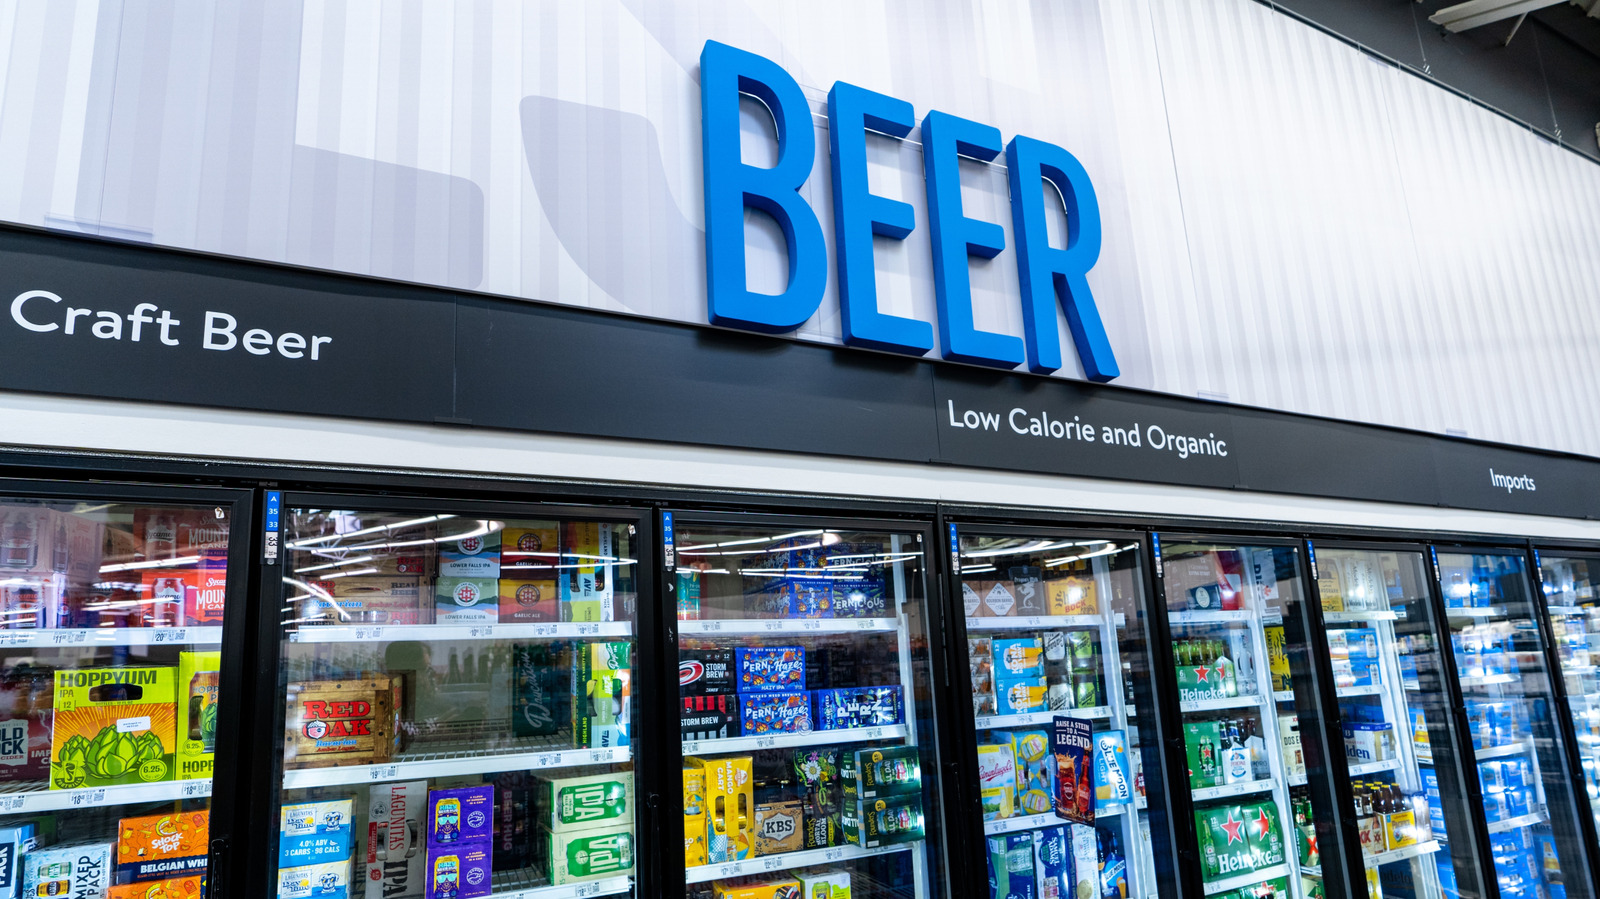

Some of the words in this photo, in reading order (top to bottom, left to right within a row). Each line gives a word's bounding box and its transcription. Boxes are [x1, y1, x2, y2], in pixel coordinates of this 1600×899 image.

[700, 39, 1120, 383] BEER
[10, 290, 180, 347] Craft
[203, 310, 332, 361] Beer
[948, 399, 1000, 432] Low
[1008, 407, 1095, 442] Calorie
[1102, 423, 1141, 447] and
[1147, 425, 1228, 459] Organic
[1489, 467, 1536, 494] Imports
[189, 528, 229, 549] MOUNT
[196, 589, 226, 610] MOUN
[1064, 600, 1087, 613] BOCK
[705, 663, 727, 671] STORM
[1010, 643, 1019, 674] KONA
[59, 670, 157, 688] HOPPYUM
[705, 670, 725, 679] BREW
[59, 689, 74, 698] IPA
[193, 686, 218, 694] HOPP
[1014, 683, 1022, 714] KONA
[62, 701, 72, 709] 12
[302, 700, 371, 719] RED
[302, 719, 371, 740] OAK
[680, 717, 700, 727] STORM
[701, 716, 719, 725] BREW
[1075, 722, 1089, 731] STEIN
[0, 727, 24, 741] LD
[1056, 733, 1090, 748] LEGEND
[1284, 736, 1295, 746] DOS
[0, 739, 25, 756] CK
[1345, 744, 1371, 760] lden
[182, 760, 214, 773] HOPP
[865, 762, 874, 786] Founders
[726, 761, 734, 794] MANGO
[503, 790, 512, 823] BEER
[575, 784, 605, 821] IPA
[389, 786, 407, 851] LAGUNITAS
[765, 820, 793, 834] KBS
[867, 811, 878, 836] Founders
[151, 833, 184, 849] SHOCK
[503, 824, 512, 851] HUG
[807, 818, 816, 848] Founders
[159, 841, 180, 854] TOP
[290, 848, 311, 856] CARBS
[588, 835, 620, 873] IPA
[140, 860, 185, 874] BELGIAN
[187, 858, 208, 868] WHI
[1218, 850, 1273, 874] Heineke
[75, 855, 91, 899] MIXED
[87, 860, 102, 896] PACK
[383, 859, 409, 898] IPA
